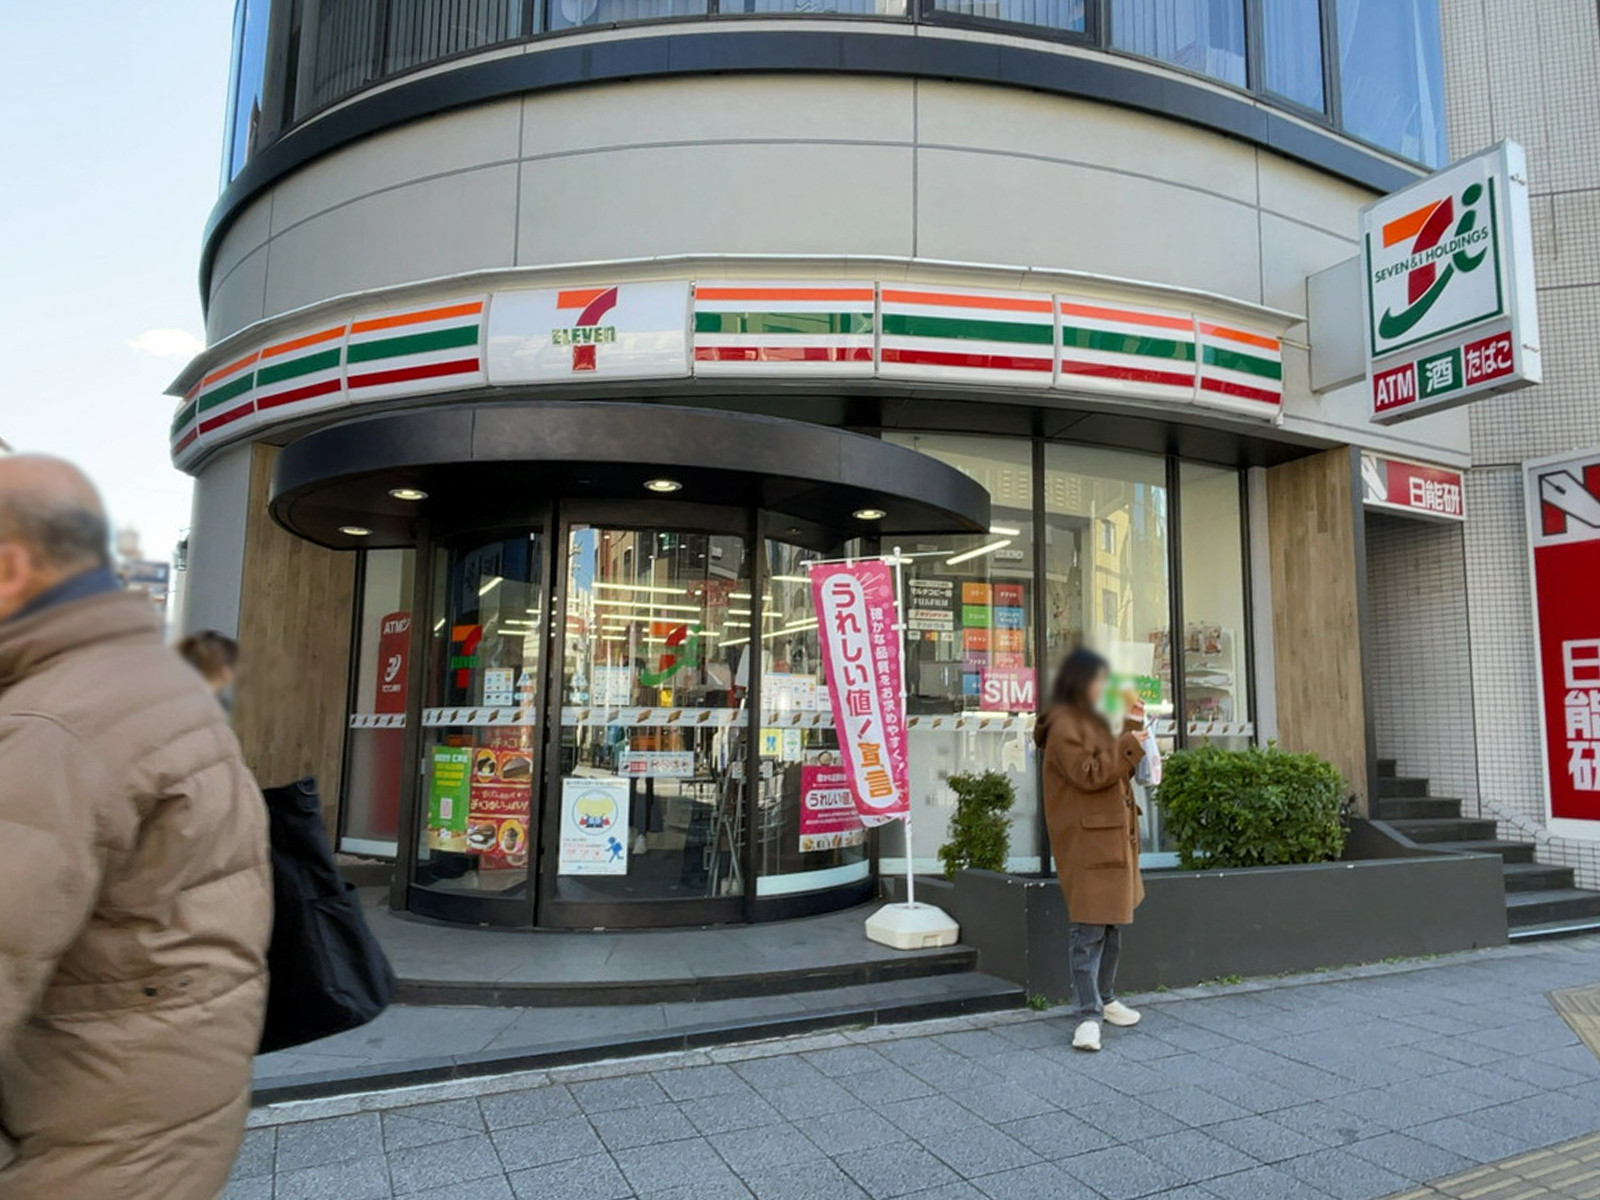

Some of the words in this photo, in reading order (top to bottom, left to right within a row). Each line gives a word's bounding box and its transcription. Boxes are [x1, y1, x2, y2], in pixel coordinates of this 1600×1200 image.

[1425, 226, 1489, 262] HOLDINGS
[1376, 369, 1413, 407] ATM
[1425, 356, 1454, 393] 酒
[1466, 341, 1512, 379] たばこ
[1409, 476, 1461, 515] 日能研
[984, 680, 1033, 704] SIM
